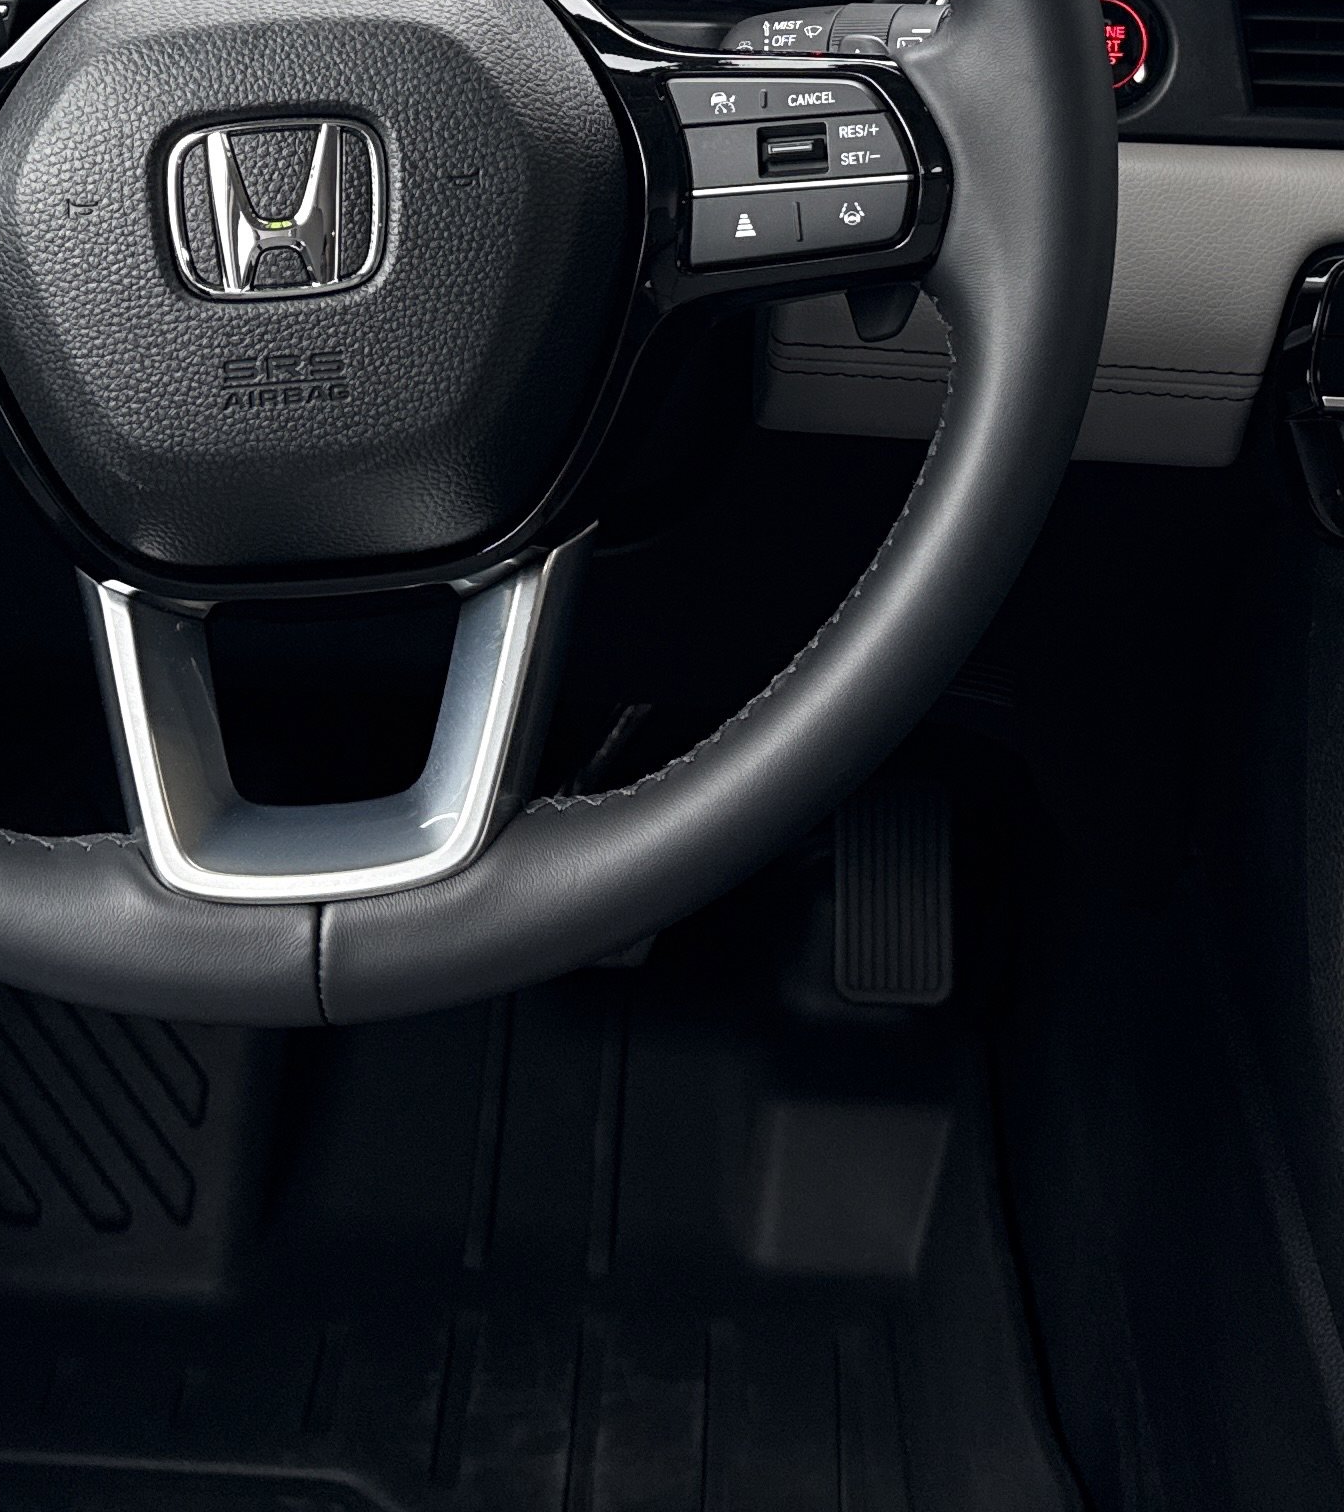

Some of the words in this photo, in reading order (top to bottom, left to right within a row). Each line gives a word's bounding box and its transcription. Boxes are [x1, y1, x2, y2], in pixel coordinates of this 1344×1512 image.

[773, 20, 804, 31] MIST
[771, 35, 797, 47] OFF
[787, 92, 836, 107] CANCEL
[839, 123, 880, 139] RES/+
[223, 350, 346, 384] SRS
